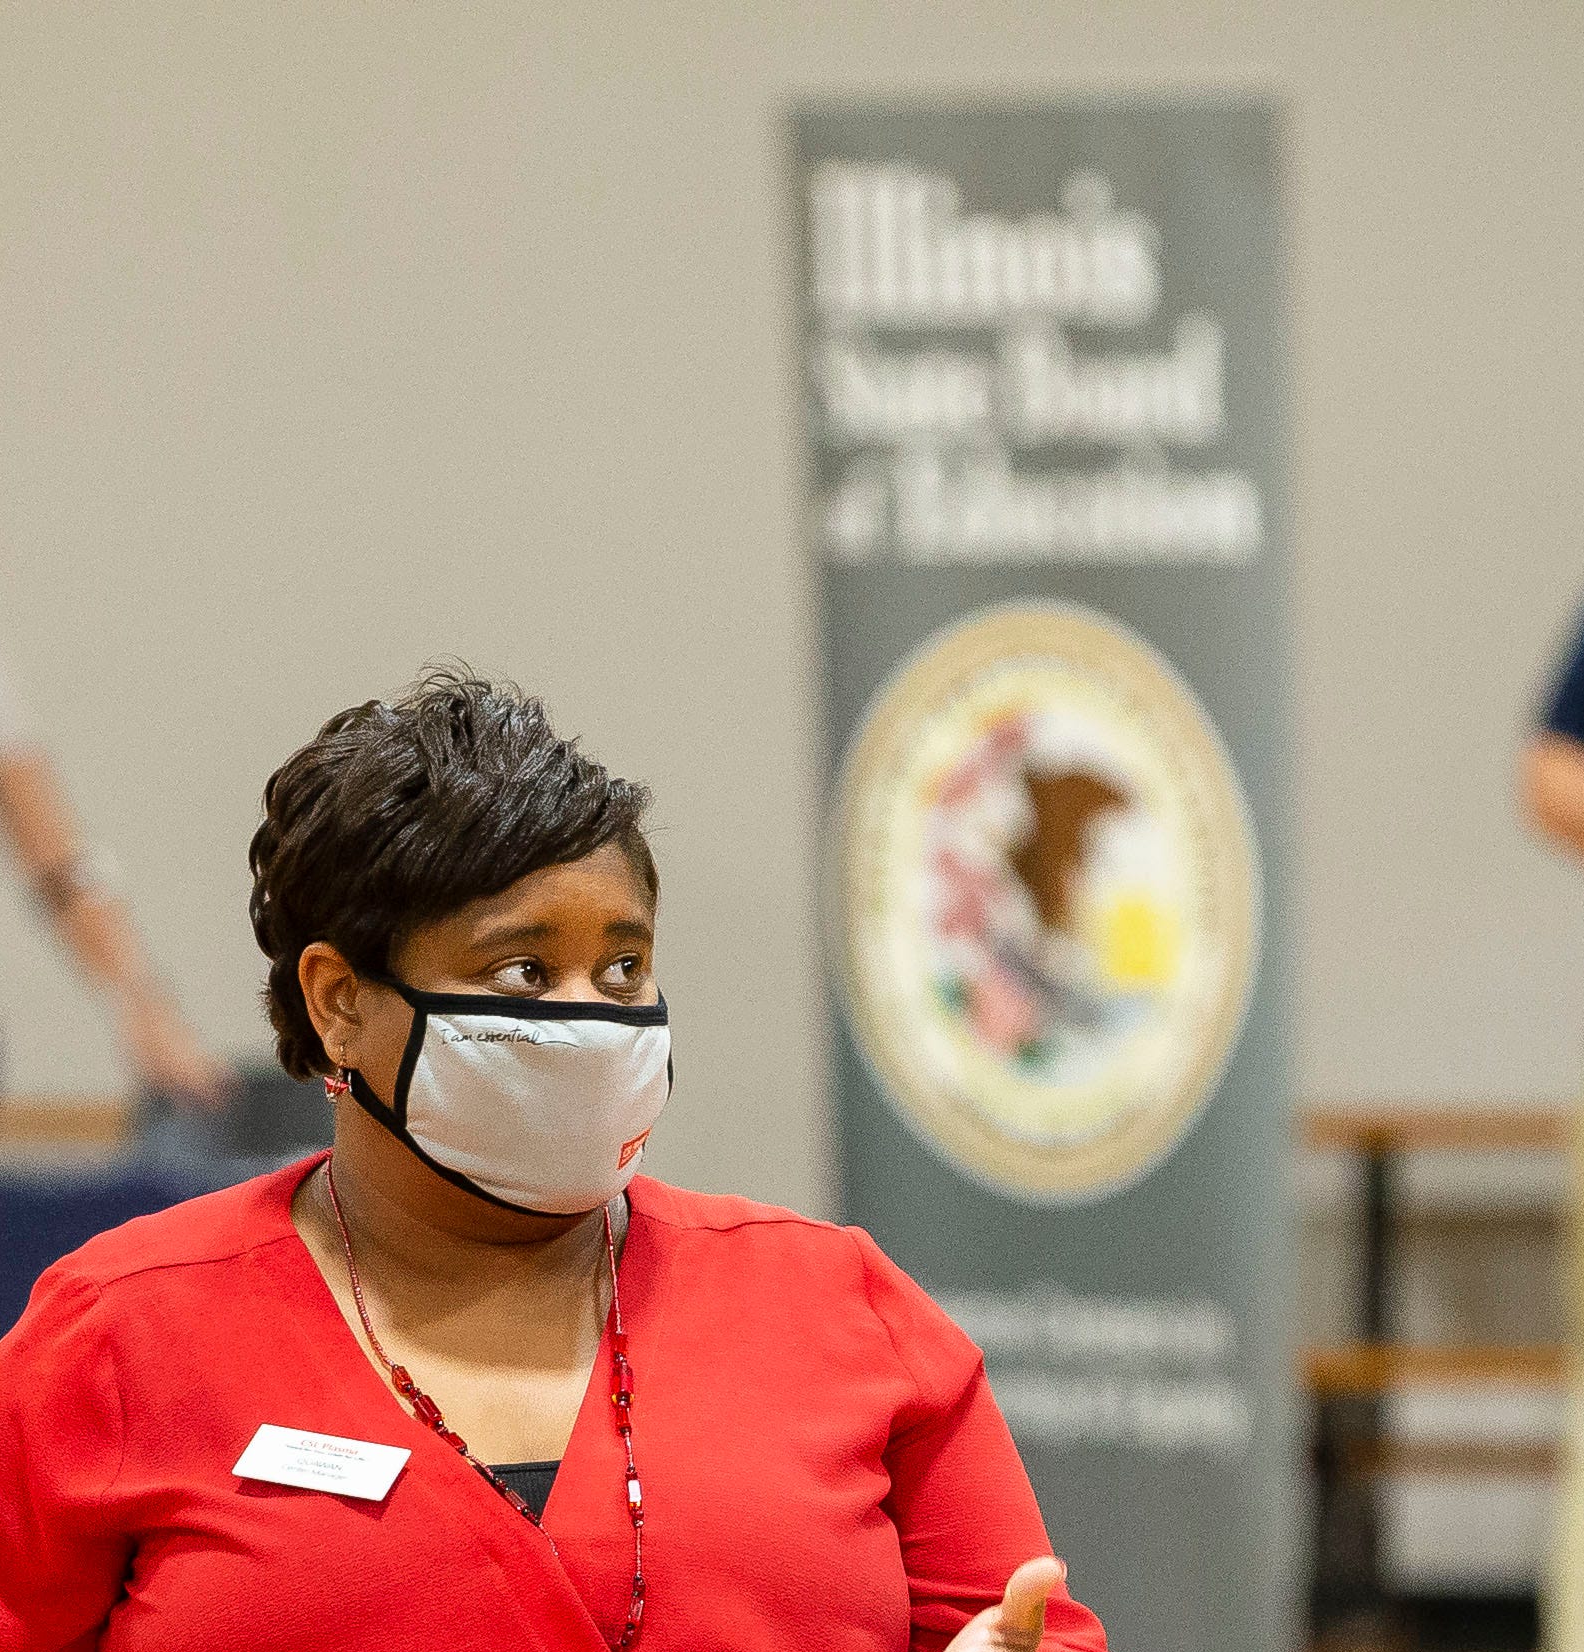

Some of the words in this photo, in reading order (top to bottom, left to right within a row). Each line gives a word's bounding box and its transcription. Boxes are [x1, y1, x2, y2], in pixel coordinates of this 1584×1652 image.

[813, 163, 1161, 318] Illinois
[895, 446, 1263, 560] Education
[451, 1033, 474, 1044] am
[476, 1025, 555, 1047] essential
